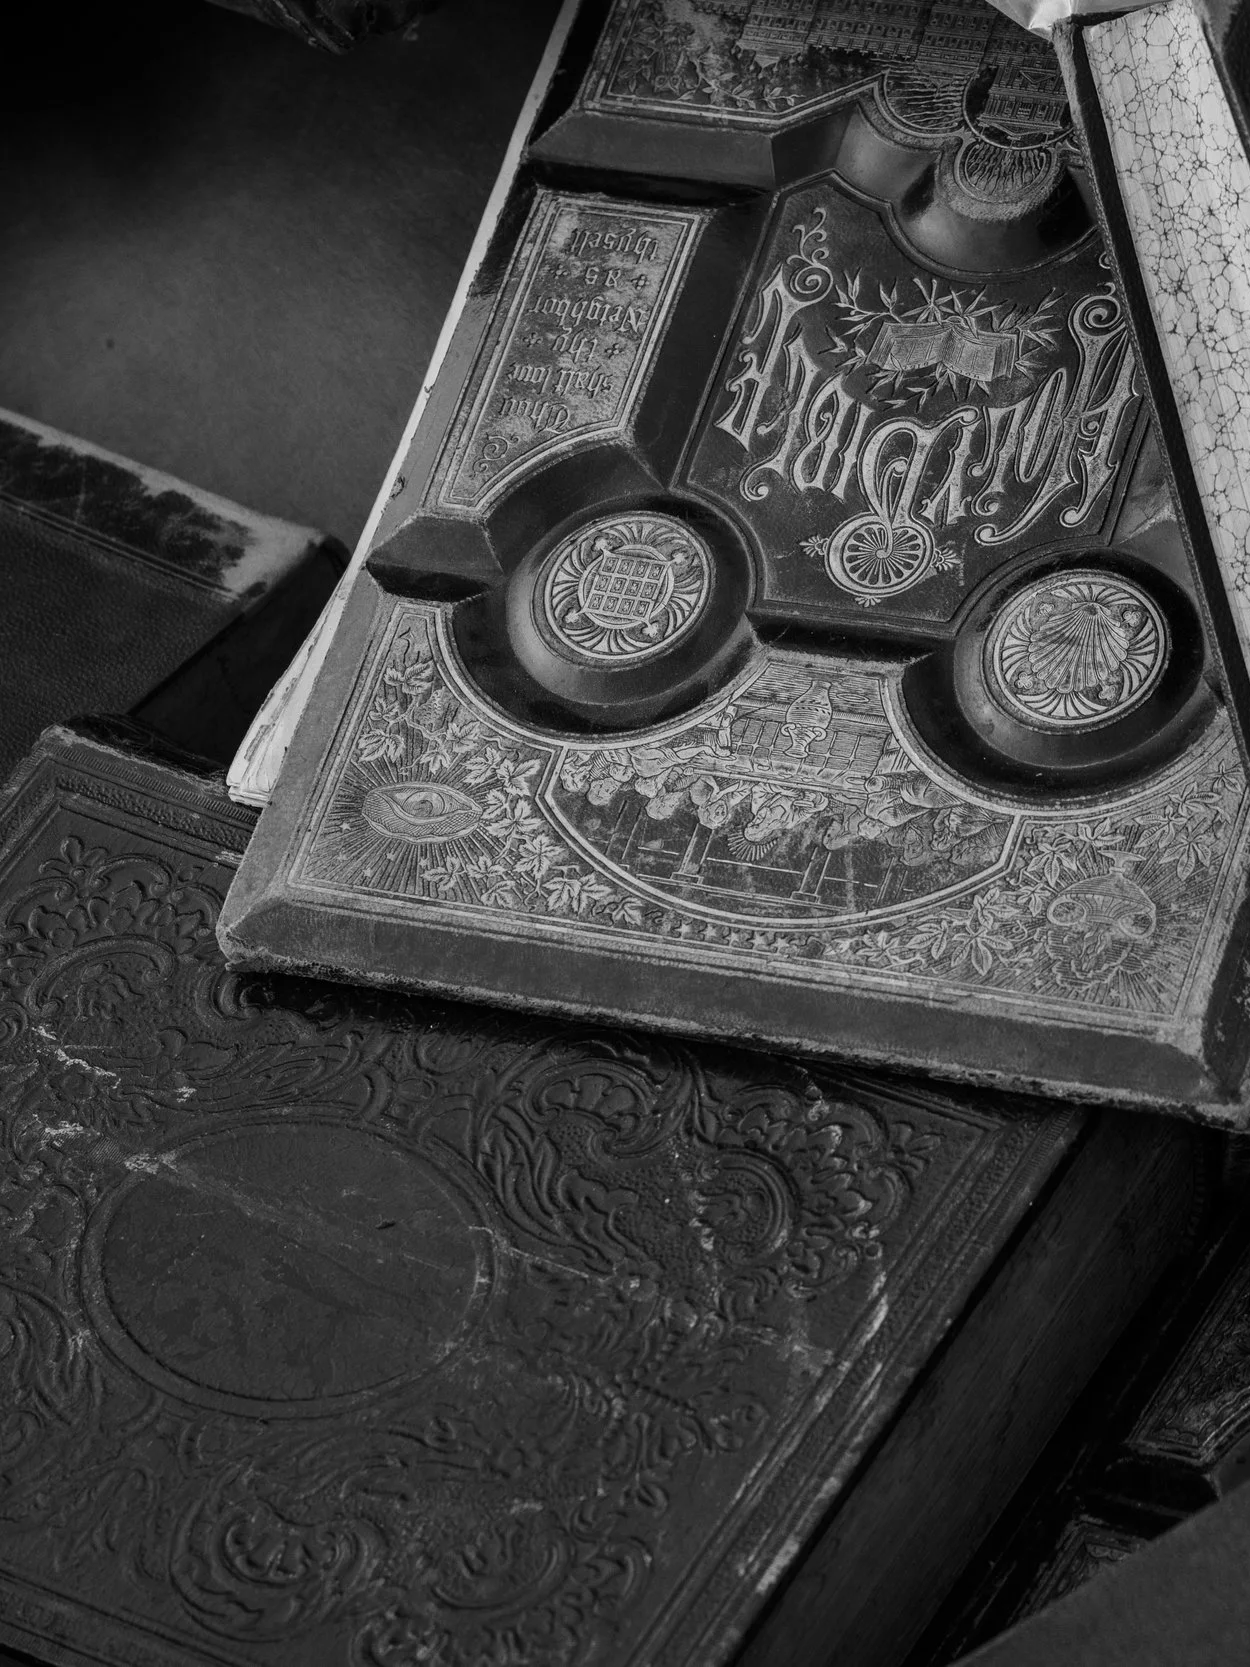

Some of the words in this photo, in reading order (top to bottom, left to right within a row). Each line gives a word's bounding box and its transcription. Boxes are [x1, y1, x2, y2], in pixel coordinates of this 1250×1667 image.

[570, 227, 658, 264] thyself
[584, 266, 622, 288] as
[529, 295, 649, 334] Neighbor
[552, 327, 598, 362] thy
[507, 362, 551, 396] love
[554, 366, 613, 398] shalt
[500, 398, 571, 435] Thou
[713, 262, 980, 596] BIBLE
[918, 284, 1140, 546] HOLY
